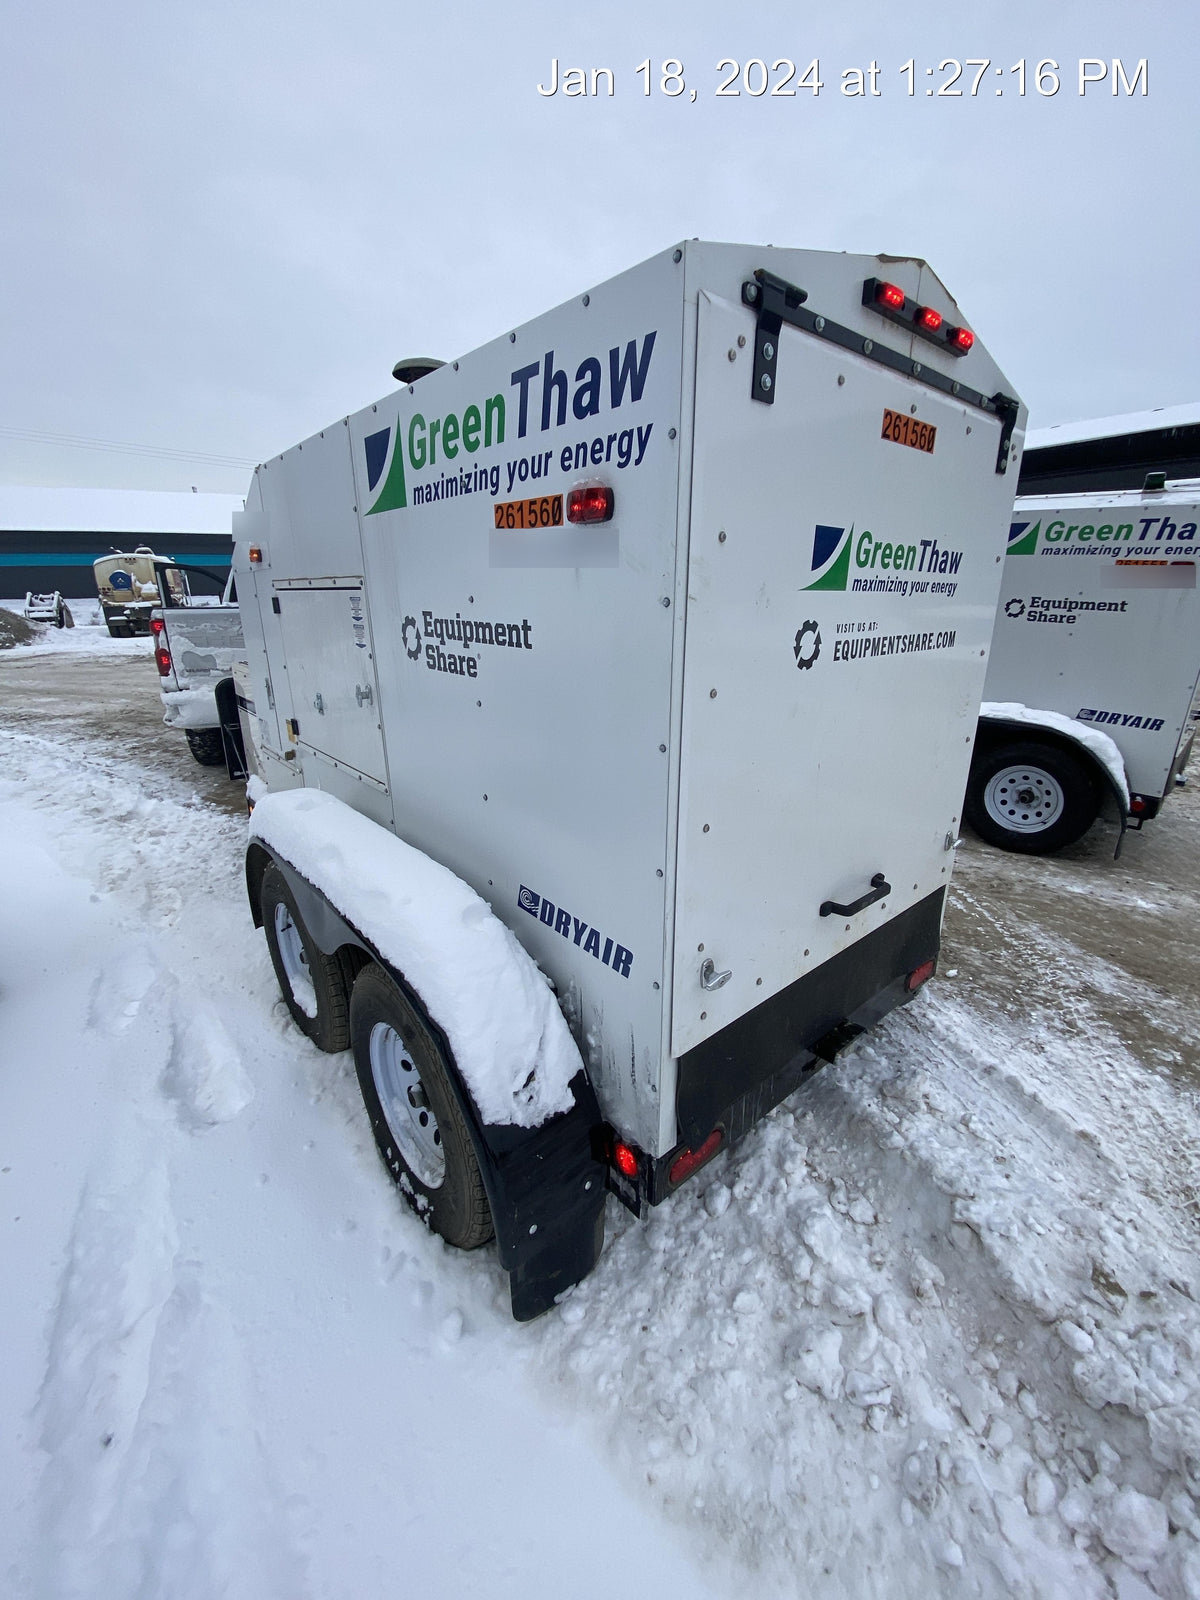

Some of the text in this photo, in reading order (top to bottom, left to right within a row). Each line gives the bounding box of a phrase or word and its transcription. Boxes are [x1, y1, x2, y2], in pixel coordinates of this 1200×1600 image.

[882, 411, 936, 452] 261560
[413, 423, 654, 505] maximizing your energy
[495, 495, 563, 529] 261560
[1041, 545, 1200, 557] maximizing your ener
[852, 575, 958, 597] maximizing your energy
[1027, 611, 1077, 624] Share
[1029, 596, 1128, 613] Equipment
[422, 611, 533, 649] Equipment
[836, 621, 878, 633] VISIT US AT:
[425, 644, 478, 678] Share
[833, 631, 956, 662] EQUIPMENTSHARE.COM
[1094, 710, 1166, 731] DRYAIR
[539, 898, 634, 979] DRYAIR
